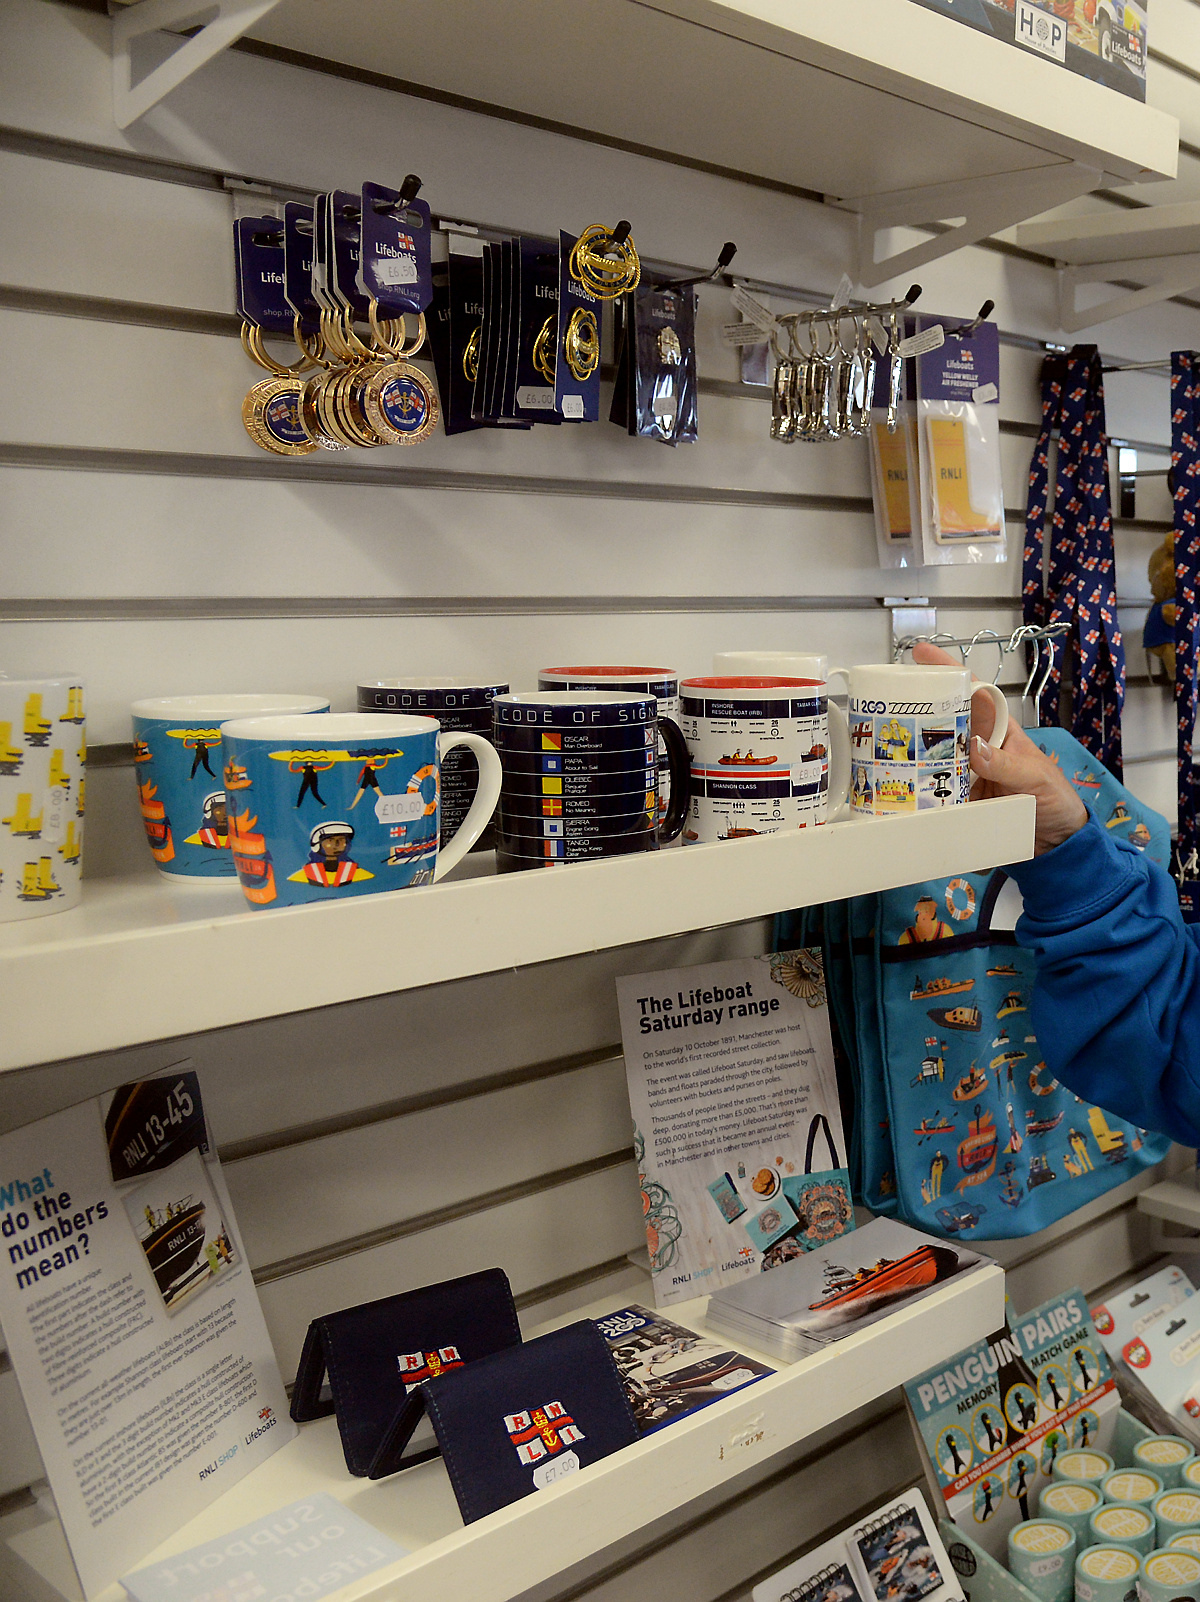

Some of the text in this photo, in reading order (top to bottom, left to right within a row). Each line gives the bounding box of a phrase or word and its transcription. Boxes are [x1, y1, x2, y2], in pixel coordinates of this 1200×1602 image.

[1111, 41, 1142, 66] Lifeboats
[375, 242, 417, 264] Lifeboats
[388, 266, 416, 278] £6.50
[567, 280, 596, 303] Lifeboats
[946, 360, 974, 370] Lifeboats
[525, 394, 553, 404] £6.00
[940, 467, 962, 480] RNLI
[374, 694, 470, 706] CODE OF
[942, 695, 963, 711] £5.00
[501, 706, 657, 723] CODE OF SIGN
[799, 767, 821, 780] £8.00
[50, 790, 62, 828] £8.00
[381, 800, 422, 816] £10.00
[637, 981, 753, 1015] The Lifeboat
[639, 998, 780, 1034] Saturday range
[642, 1050, 653, 1059] On
[654, 1044, 684, 1059] Saturday
[684, 1043, 692, 1051] 10
[693, 1038, 720, 1049] October
[738, 1028, 773, 1041] Manchester
[787, 1023, 800, 1032] host
[646, 1077, 658, 1086] The
[659, 1073, 677, 1083] event
[678, 1072, 691, 1080] was
[691, 1066, 710, 1077] called
[711, 1061, 736, 1073] Lifeboat
[736, 1056, 764, 1070] Saturday,
[765, 1053, 777, 1062] and
[789, 1045, 816, 1057] lifeboats,
[651, 1083, 810, 1125] Thousands of people lined the streets and they dug
[671, 1118, 700, 1133] donating
[701, 1116, 717, 1125] more
[718, 1111, 733, 1121] than
[758, 1101, 776, 1112] That's
[777, 1099, 793, 1108] more
[793, 1094, 808, 1104] than
[122, 1079, 195, 1169] RNLI 13-45
[653, 1132, 686, 1147] £500,000
[687, 1131, 693, 1139] in
[694, 1125, 717, 1139] today's
[742, 1114, 767, 1126] Lifeboat
[768, 1108, 795, 1122] Saturday
[0, 1167, 55, 1211] What
[1, 1191, 72, 1238] do the
[8, 1200, 109, 1264] numbers
[167, 1232, 187, 1251] RNLI
[16, 1232, 90, 1290] mean?
[721, 1256, 756, 1272] Lifeboats
[672, 1267, 714, 1285] RNLI SHOP
[597, 1312, 637, 1330] RNLI
[917, 1299, 1083, 1412] PENGUIN PAIRS
[722, 1370, 750, 1385] £1.00
[956, 1326, 1090, 1415] MEMORY MATCH GAME
[244, 1417, 278, 1446] Lifeboats
[198, 1444, 239, 1481] RNLI SHOP
[544, 1458, 576, 1483] £7.00
[953, 1478, 968, 1491] CAN
[967, 1469, 982, 1483] YOU
[980, 1444, 1013, 1474] REMEMBER
